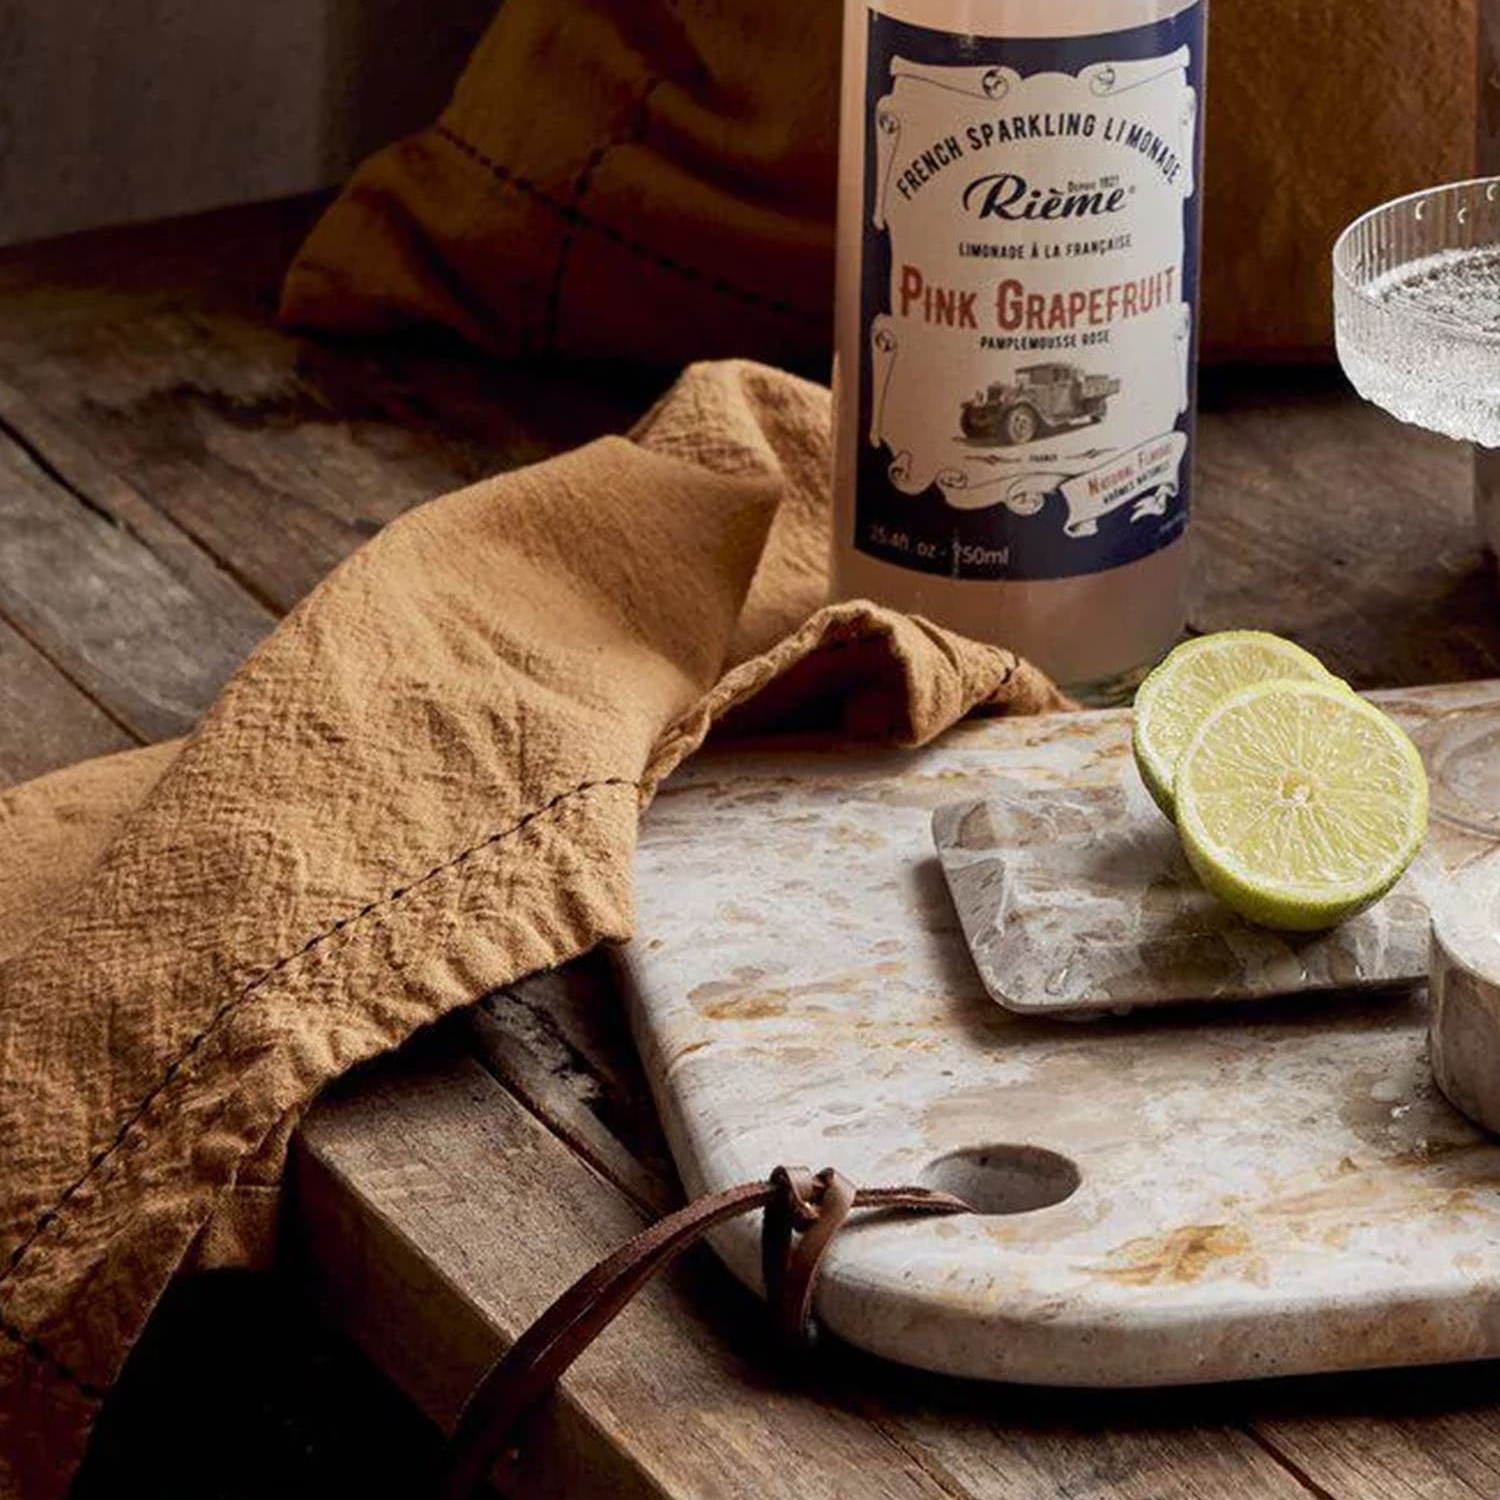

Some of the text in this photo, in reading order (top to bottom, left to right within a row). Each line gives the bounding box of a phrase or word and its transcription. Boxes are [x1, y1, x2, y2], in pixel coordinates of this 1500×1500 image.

[896, 113, 1181, 201] FRENCH SPARKLING LIMONADE
[962, 173, 1127, 221] Rième
[958, 243, 1024, 260] LIMONADE
[1044, 245, 1060, 259] LA
[1065, 234, 1132, 256] FRANÇAISE
[900, 264, 1175, 332] PINK GRAPEFRUIT
[980, 329, 1110, 350] PAMPLEMOUSSE ROSE
